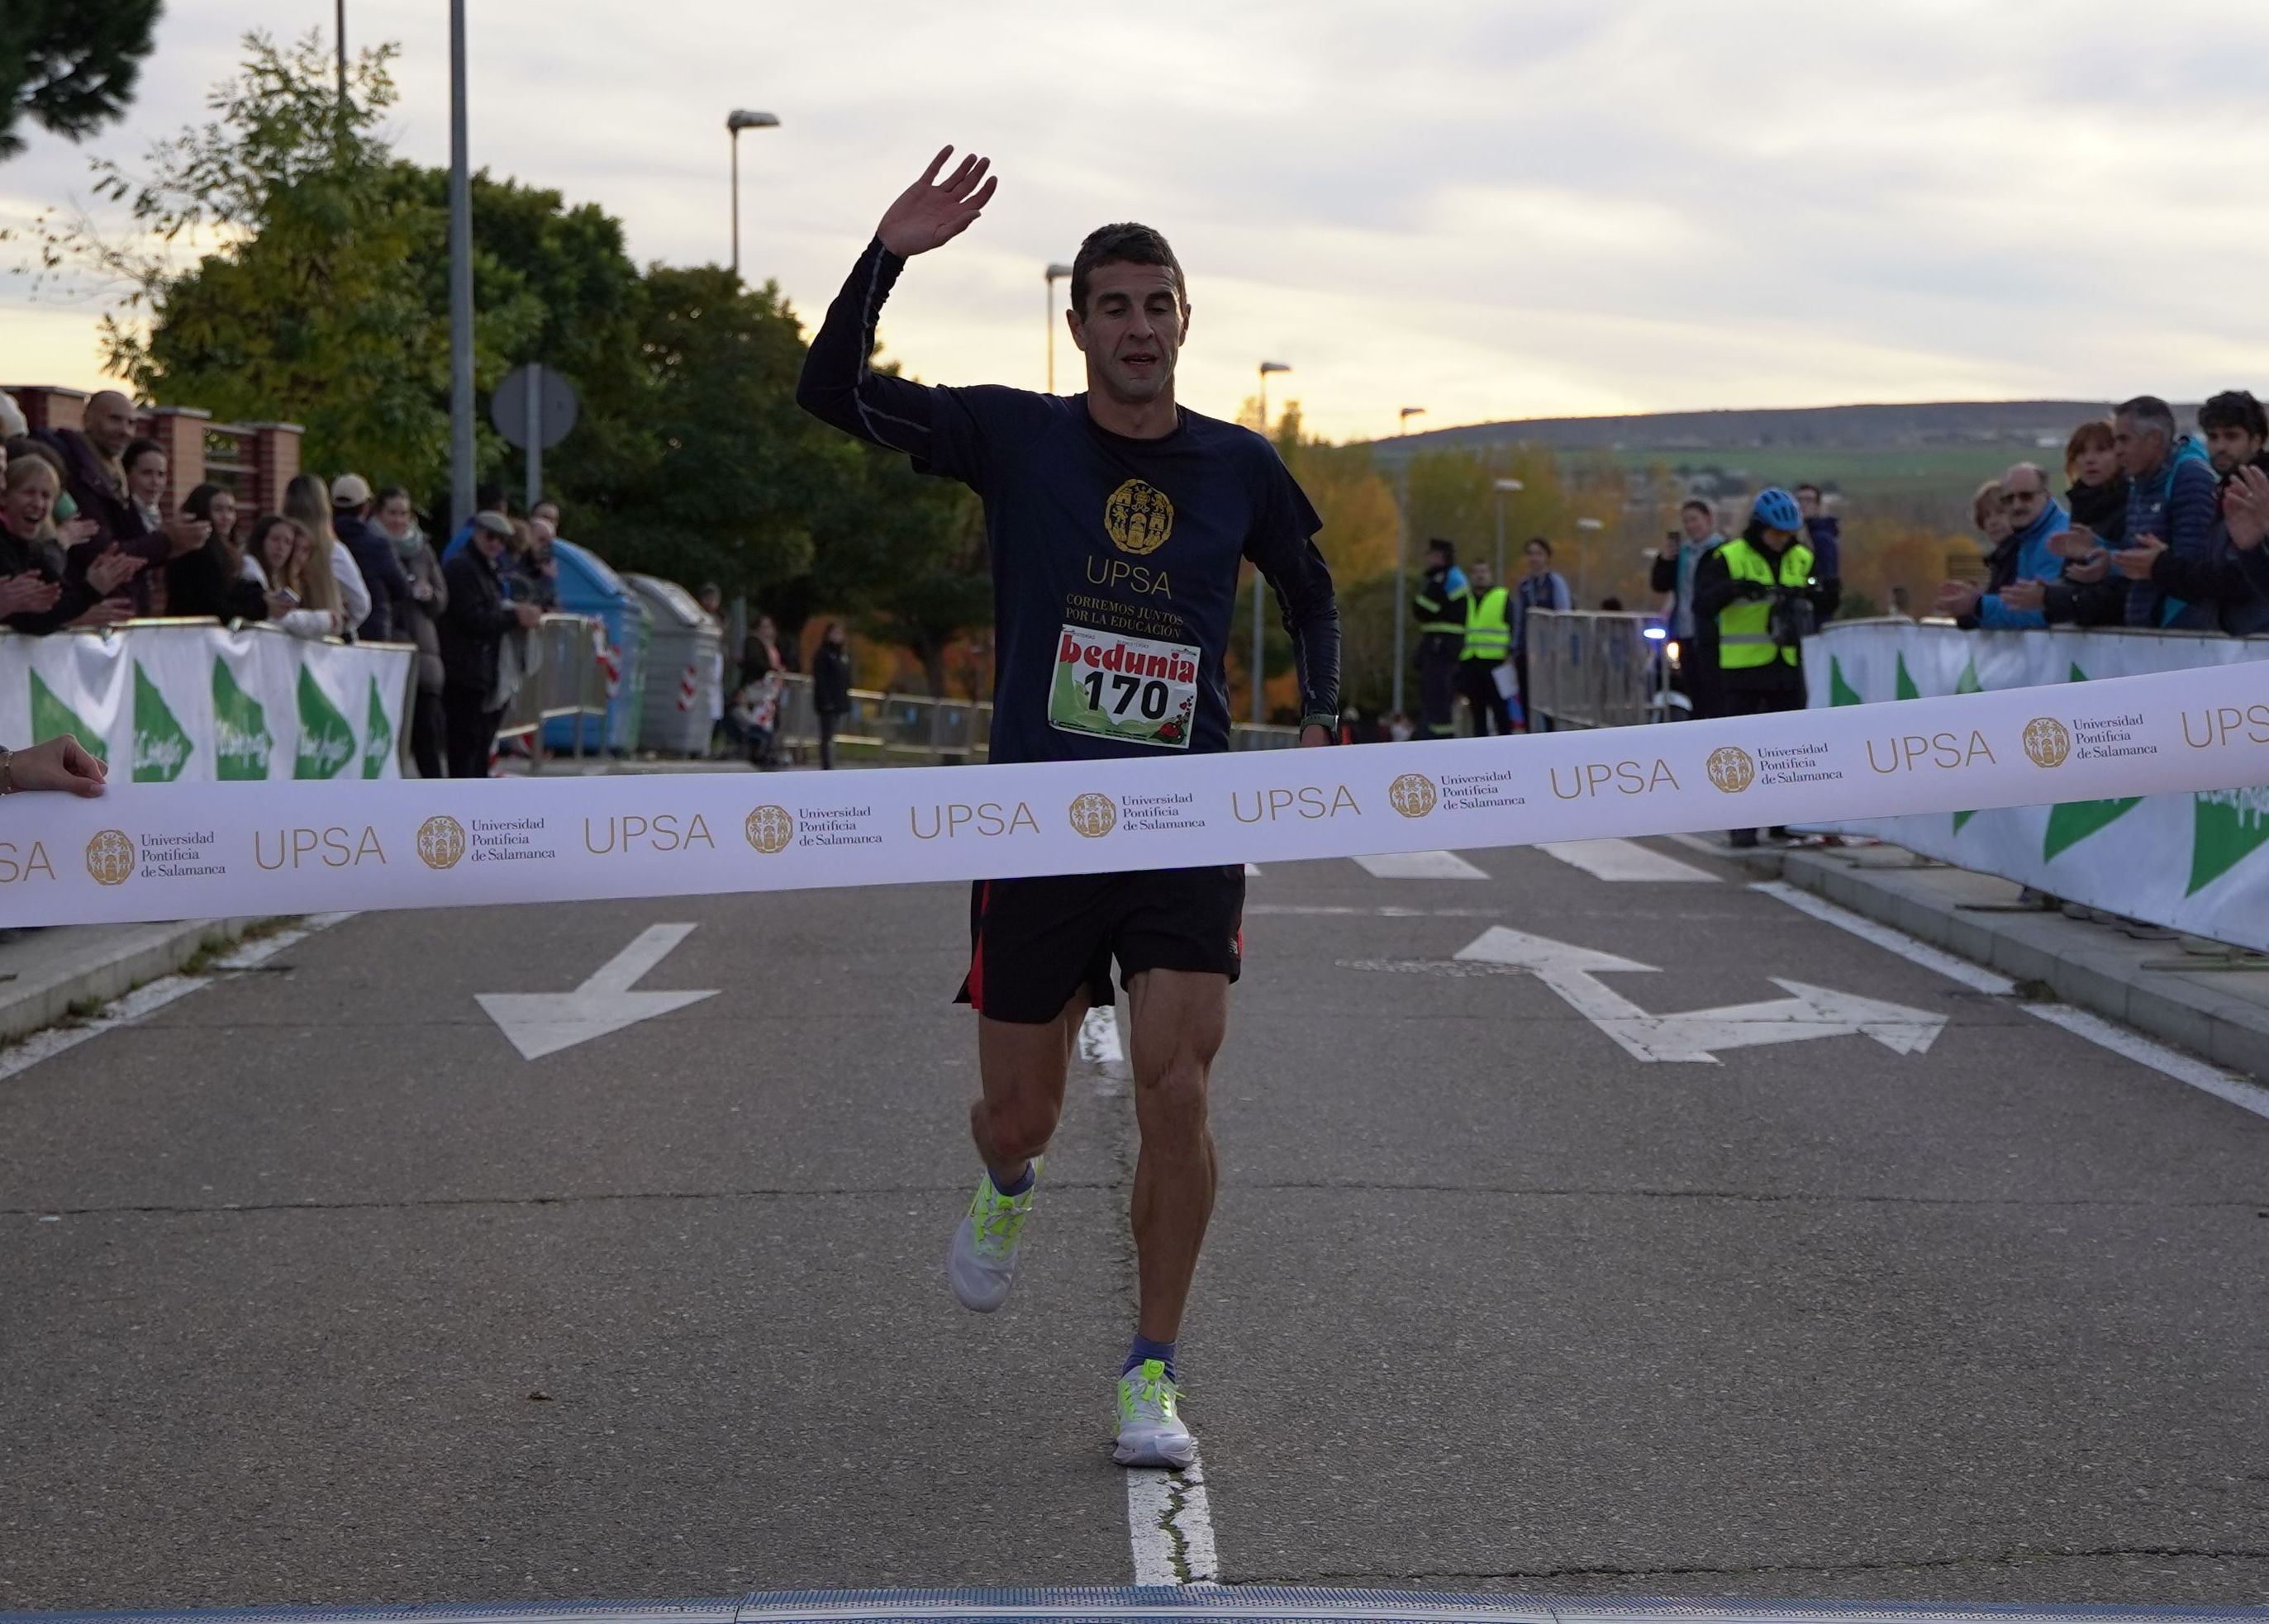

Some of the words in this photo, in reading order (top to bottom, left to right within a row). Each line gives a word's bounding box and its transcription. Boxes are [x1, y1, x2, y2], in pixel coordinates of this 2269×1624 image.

[1087, 554, 1172, 601] UPSA
[1066, 593, 1135, 616] CORREMOS
[1138, 606, 1184, 625] JUNTOS
[1065, 607, 1090, 620] POR
[1092, 613, 1107, 624] LA
[1111, 615, 1182, 639] EDUCACIÓN
[1058, 634, 1196, 684] bedunia
[1084, 670, 1169, 720] 170
[2072, 713, 2144, 731] Universidad
[2075, 729, 2132, 745] Pontificia
[1757, 742, 1829, 760] Universidad
[1867, 730, 1996, 773] UPSA
[2076, 745, 2092, 760] de
[2092, 743, 2158, 757] Salamanca
[1759, 757, 1817, 772] Pontificia
[1440, 770, 1512, 786] Universidad
[1550, 759, 1680, 799] UPSA
[1761, 773, 1777, 786] de
[1777, 771, 1843, 784] Salamanca
[1442, 782, 1501, 798] Pontificia
[1121, 792, 1193, 806] Universidad
[1233, 786, 1361, 823] UPSA
[1443, 799, 1458, 811] de
[1458, 796, 1526, 810] Salamanca
[798, 805, 871, 819] Universidad
[911, 802, 1039, 838] UPSA
[1122, 805, 1180, 819] Pontificia
[472, 817, 545, 832] Universidad
[799, 819, 857, 833] Pontificia
[1122, 819, 1139, 832] de
[1139, 819, 1206, 831] Salamanca
[140, 830, 215, 847] Universidad
[472, 832, 530, 847] Pontificia
[586, 814, 715, 853] UPSA
[798, 834, 815, 847] de
[816, 833, 882, 846] Salamanca
[140, 847, 200, 862] Pontificia
[255, 826, 386, 870] UPSA
[471, 848, 488, 862] de
[488, 848, 556, 862] Salamanca
[140, 864, 157, 878] de
[157, 863, 226, 877] Salamanca
